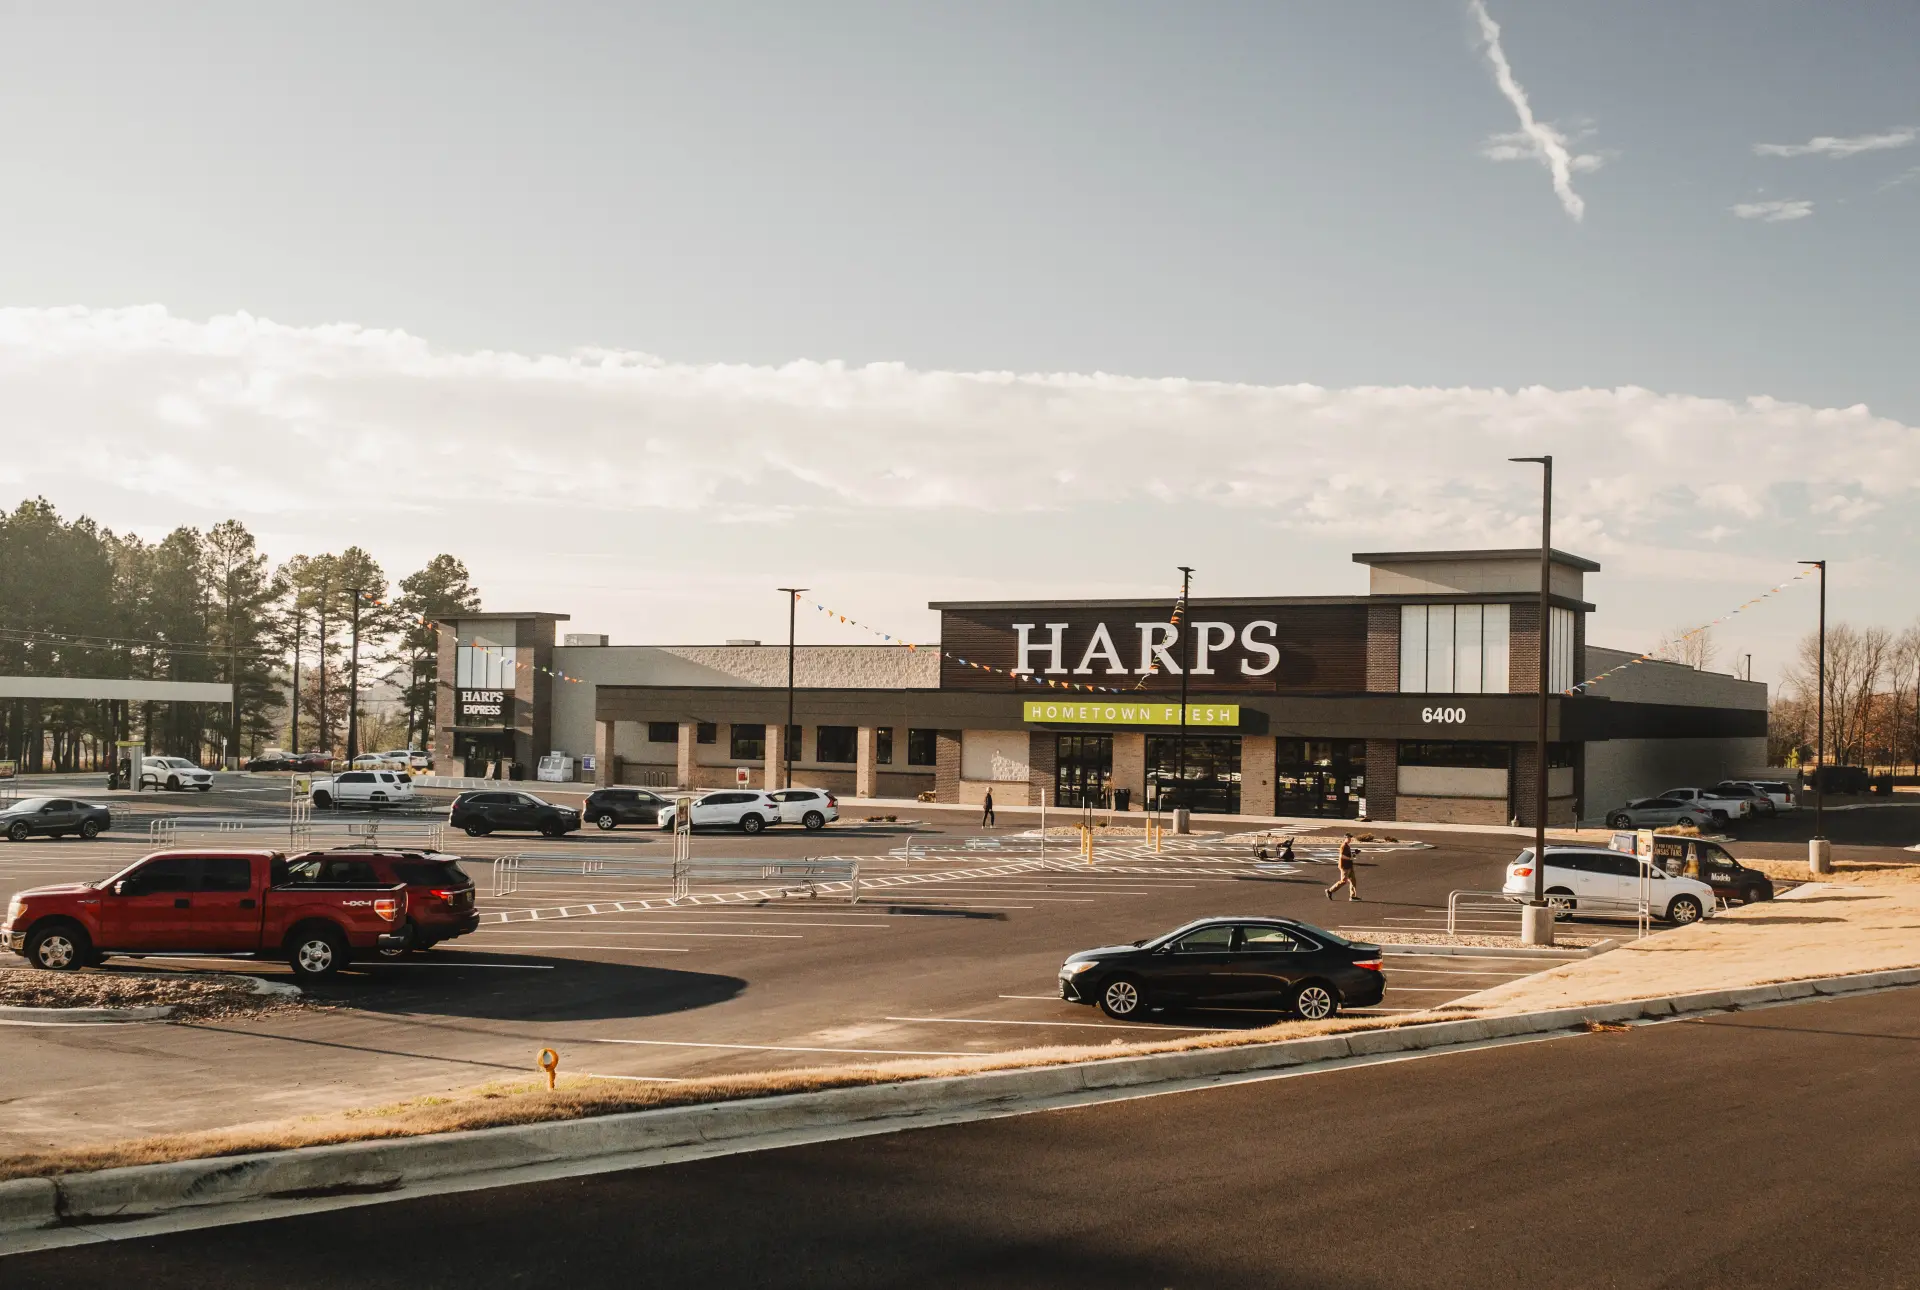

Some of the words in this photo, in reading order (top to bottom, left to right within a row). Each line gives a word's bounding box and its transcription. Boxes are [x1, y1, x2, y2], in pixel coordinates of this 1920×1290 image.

[1011, 620, 1281, 676] HARPS
[461, 691, 504, 703] HARPS
[463, 704, 502, 715] EXPRESS
[1032, 706, 1151, 720] HOMETOWN
[1422, 707, 1466, 723] 6400
[1710, 872, 1731, 882] Modelo
